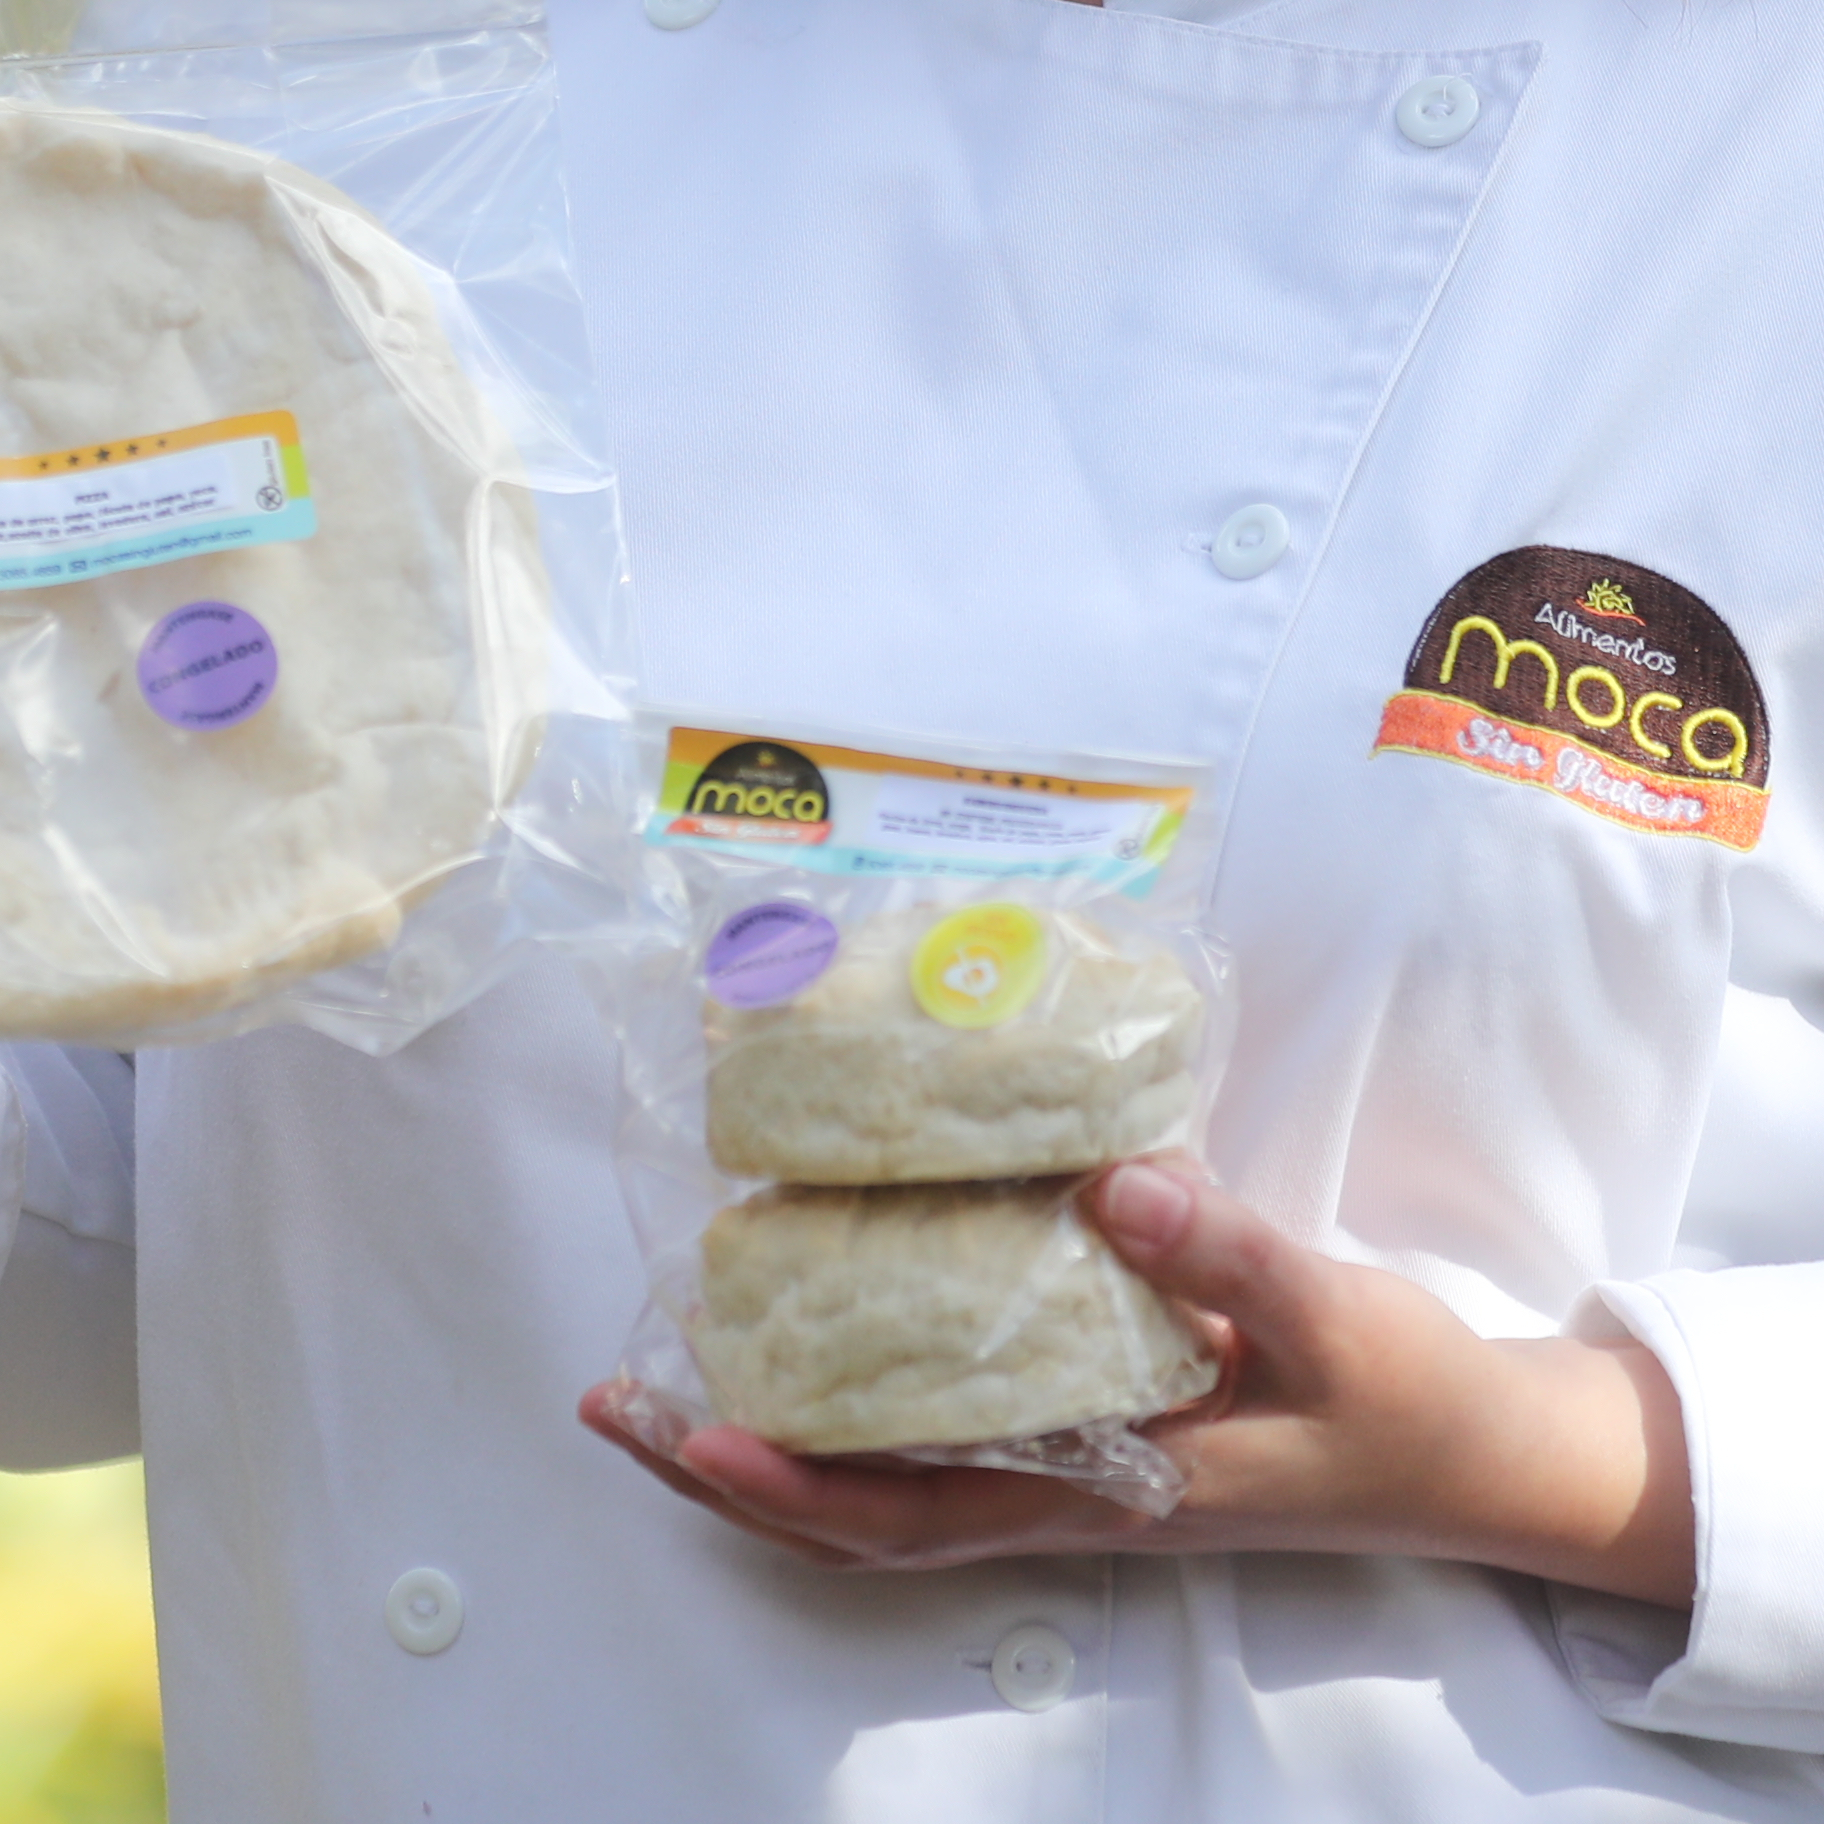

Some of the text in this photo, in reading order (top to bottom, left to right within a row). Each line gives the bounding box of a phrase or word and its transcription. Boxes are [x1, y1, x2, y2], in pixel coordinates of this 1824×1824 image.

[148, 639, 264, 694] CONGELADO
[1533, 602, 1678, 676] Alimentos
[1438, 615, 1750, 779] moca
[690, 779, 826, 824] moca
[1455, 718, 1705, 824] Sin Gluten
